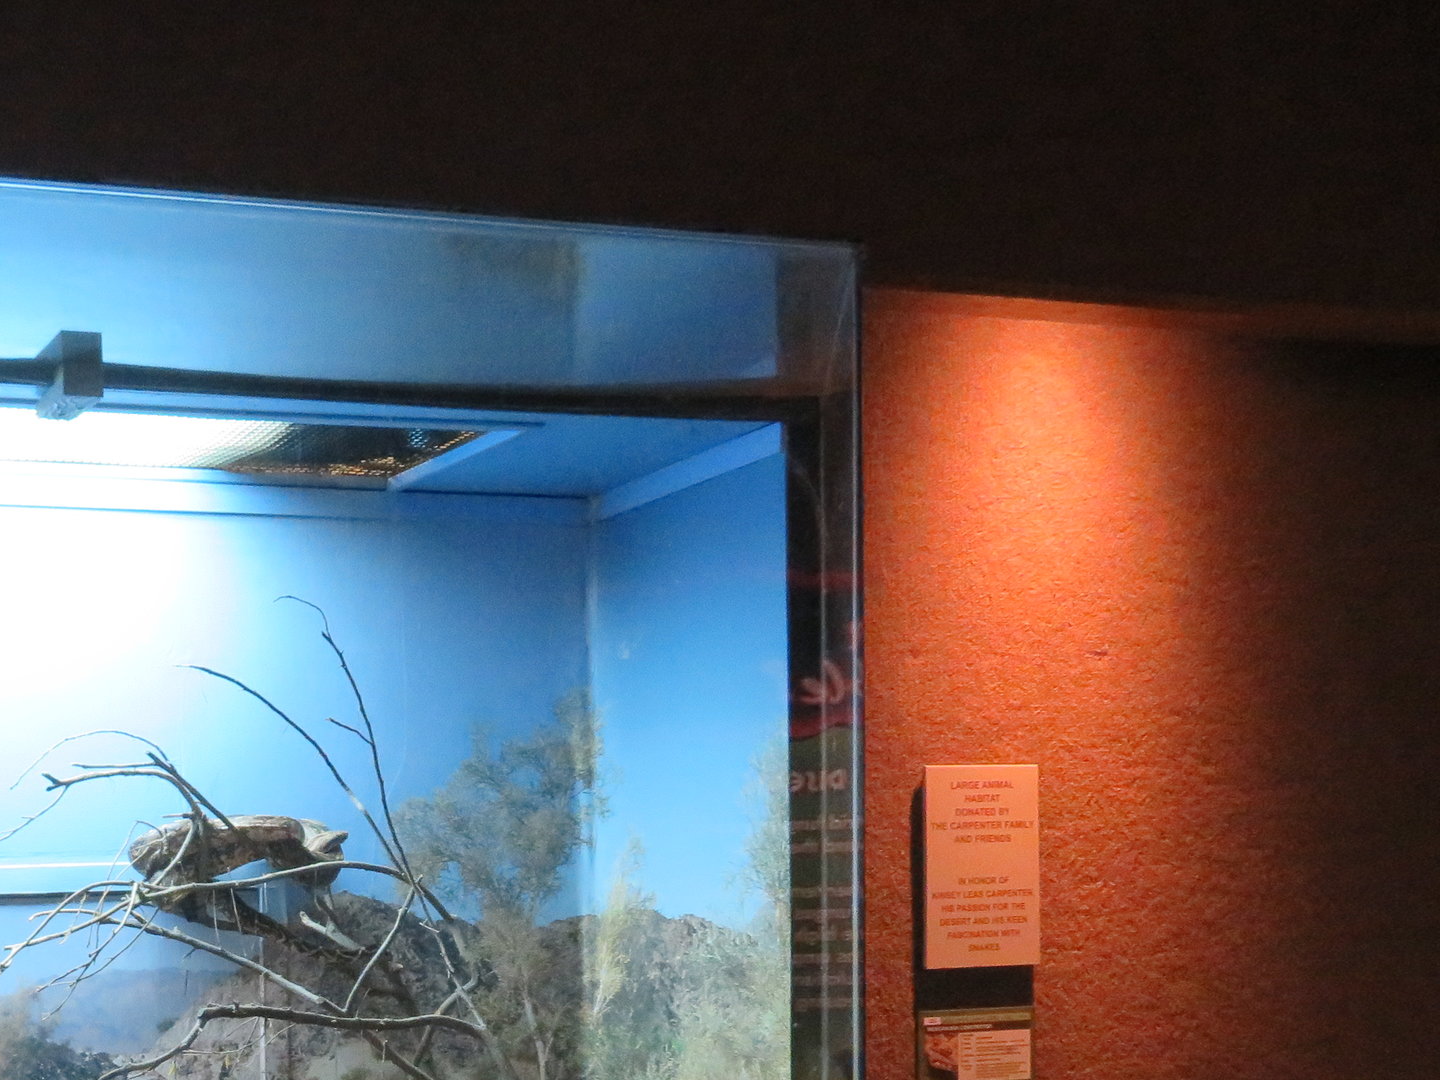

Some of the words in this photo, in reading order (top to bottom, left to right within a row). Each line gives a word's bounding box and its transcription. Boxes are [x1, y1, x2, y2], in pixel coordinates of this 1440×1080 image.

[950, 781, 980, 790] LARGE
[981, 780, 1014, 789] ANIMAL
[964, 794, 1000, 803] HABITAT
[955, 808, 996, 817] DONATED
[998, 807, 1010, 816] BY
[931, 822, 948, 831] THE
[949, 821, 1002, 830] CARPENTER
[1004, 820, 1034, 829] FAMILY
[954, 835, 972, 843] AND
[974, 834, 1012, 843] FRIENDS
[958, 877, 966, 885] IN
[968, 876, 996, 885] HONOR
[998, 876, 1010, 884] OF
[941, 904, 954, 912] HIS
[956, 903, 990, 912] PASSION
[992, 902, 1008, 911] FOR
[1011, 902, 1025, 910] THE
[939, 917, 970, 926] DESERT
[973, 916, 990, 925] AND
[991, 916, 1005, 924] HIS
[1007, 915, 1028, 924] KEEN
[946, 930, 999, 939] FASCINATION
[1000, 929, 1021, 937] WITH
[968, 943, 1001, 952] SNAKES
